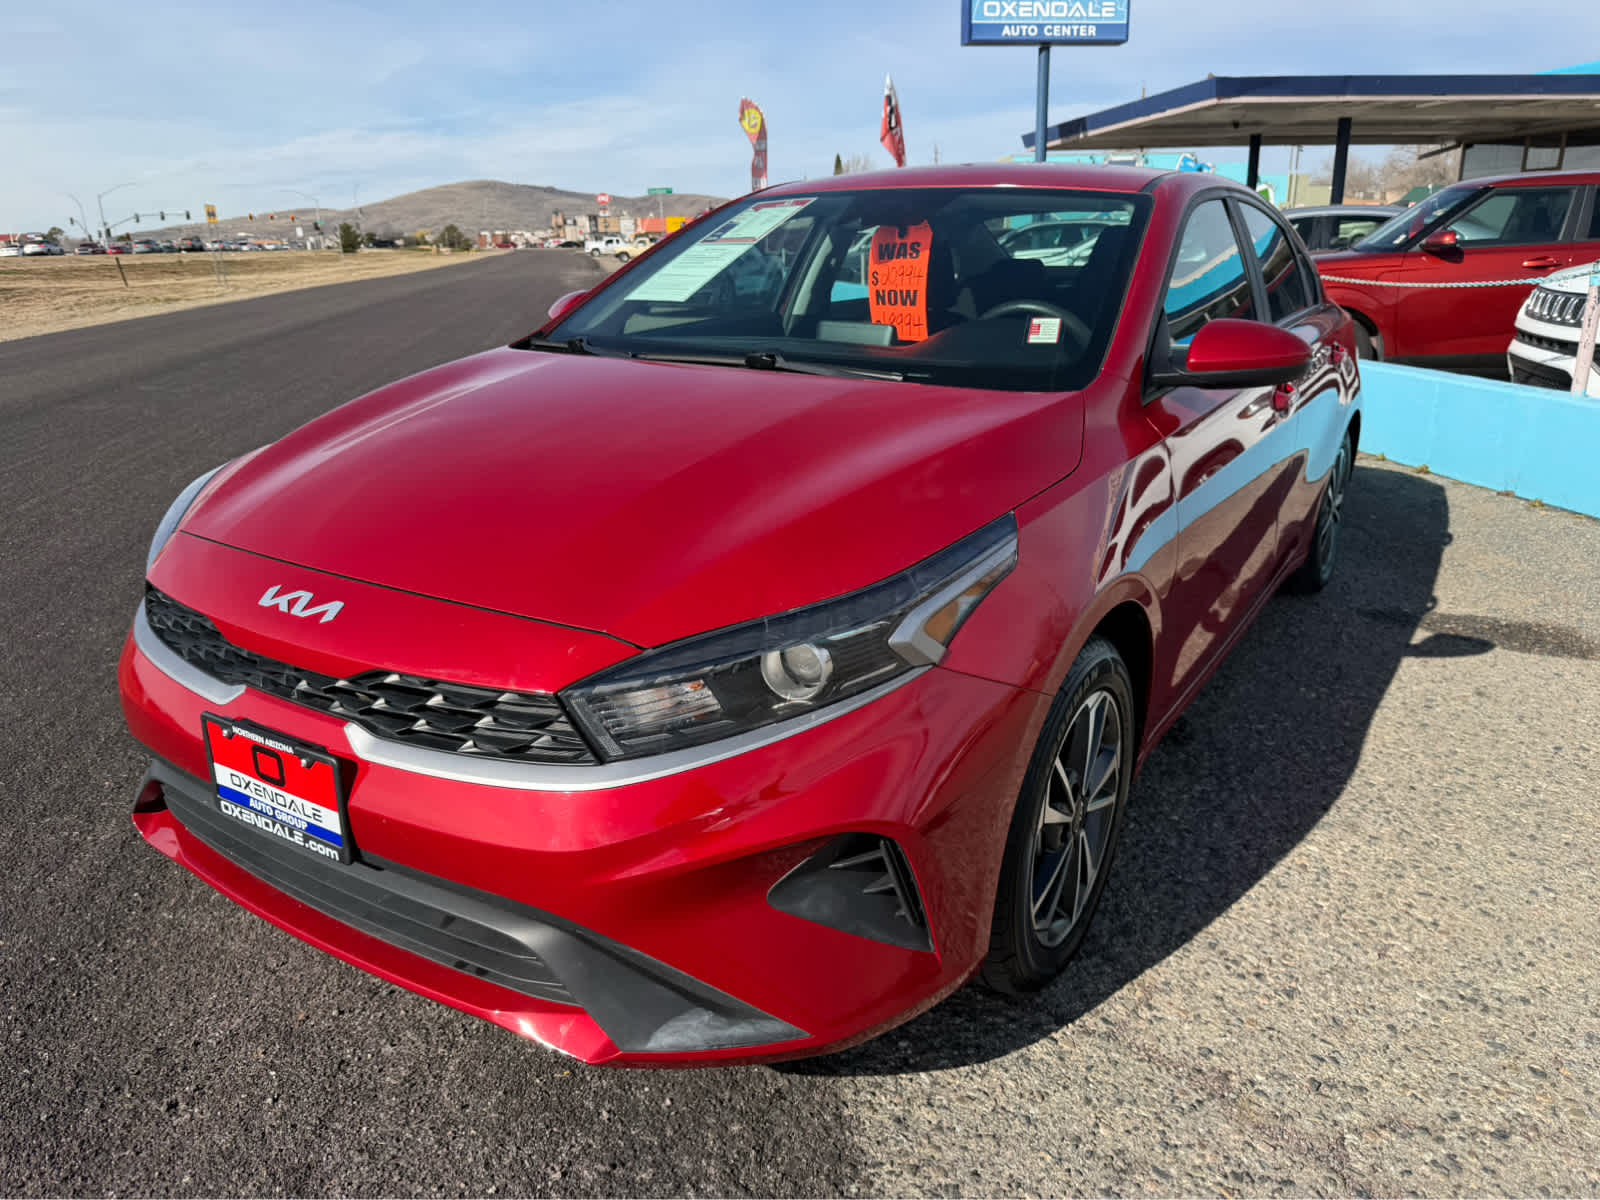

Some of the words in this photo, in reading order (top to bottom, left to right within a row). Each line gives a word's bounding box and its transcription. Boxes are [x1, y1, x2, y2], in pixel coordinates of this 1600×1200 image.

[983, 1, 1116, 18] OXENDALE
[1002, 25, 1038, 37] AUTO
[1043, 25, 1097, 37] CENTER
[878, 241, 922, 261] WAS
[875, 289, 918, 307] NOW
[231, 725, 265, 745] NORTHERN
[264, 738, 295, 755] ARIZONA
[230, 773, 324, 824] OXENDALE
[249, 798, 274, 817] AUTO
[274, 809, 309, 831] GROUP
[220, 800, 340, 861] OXENDALE.com
